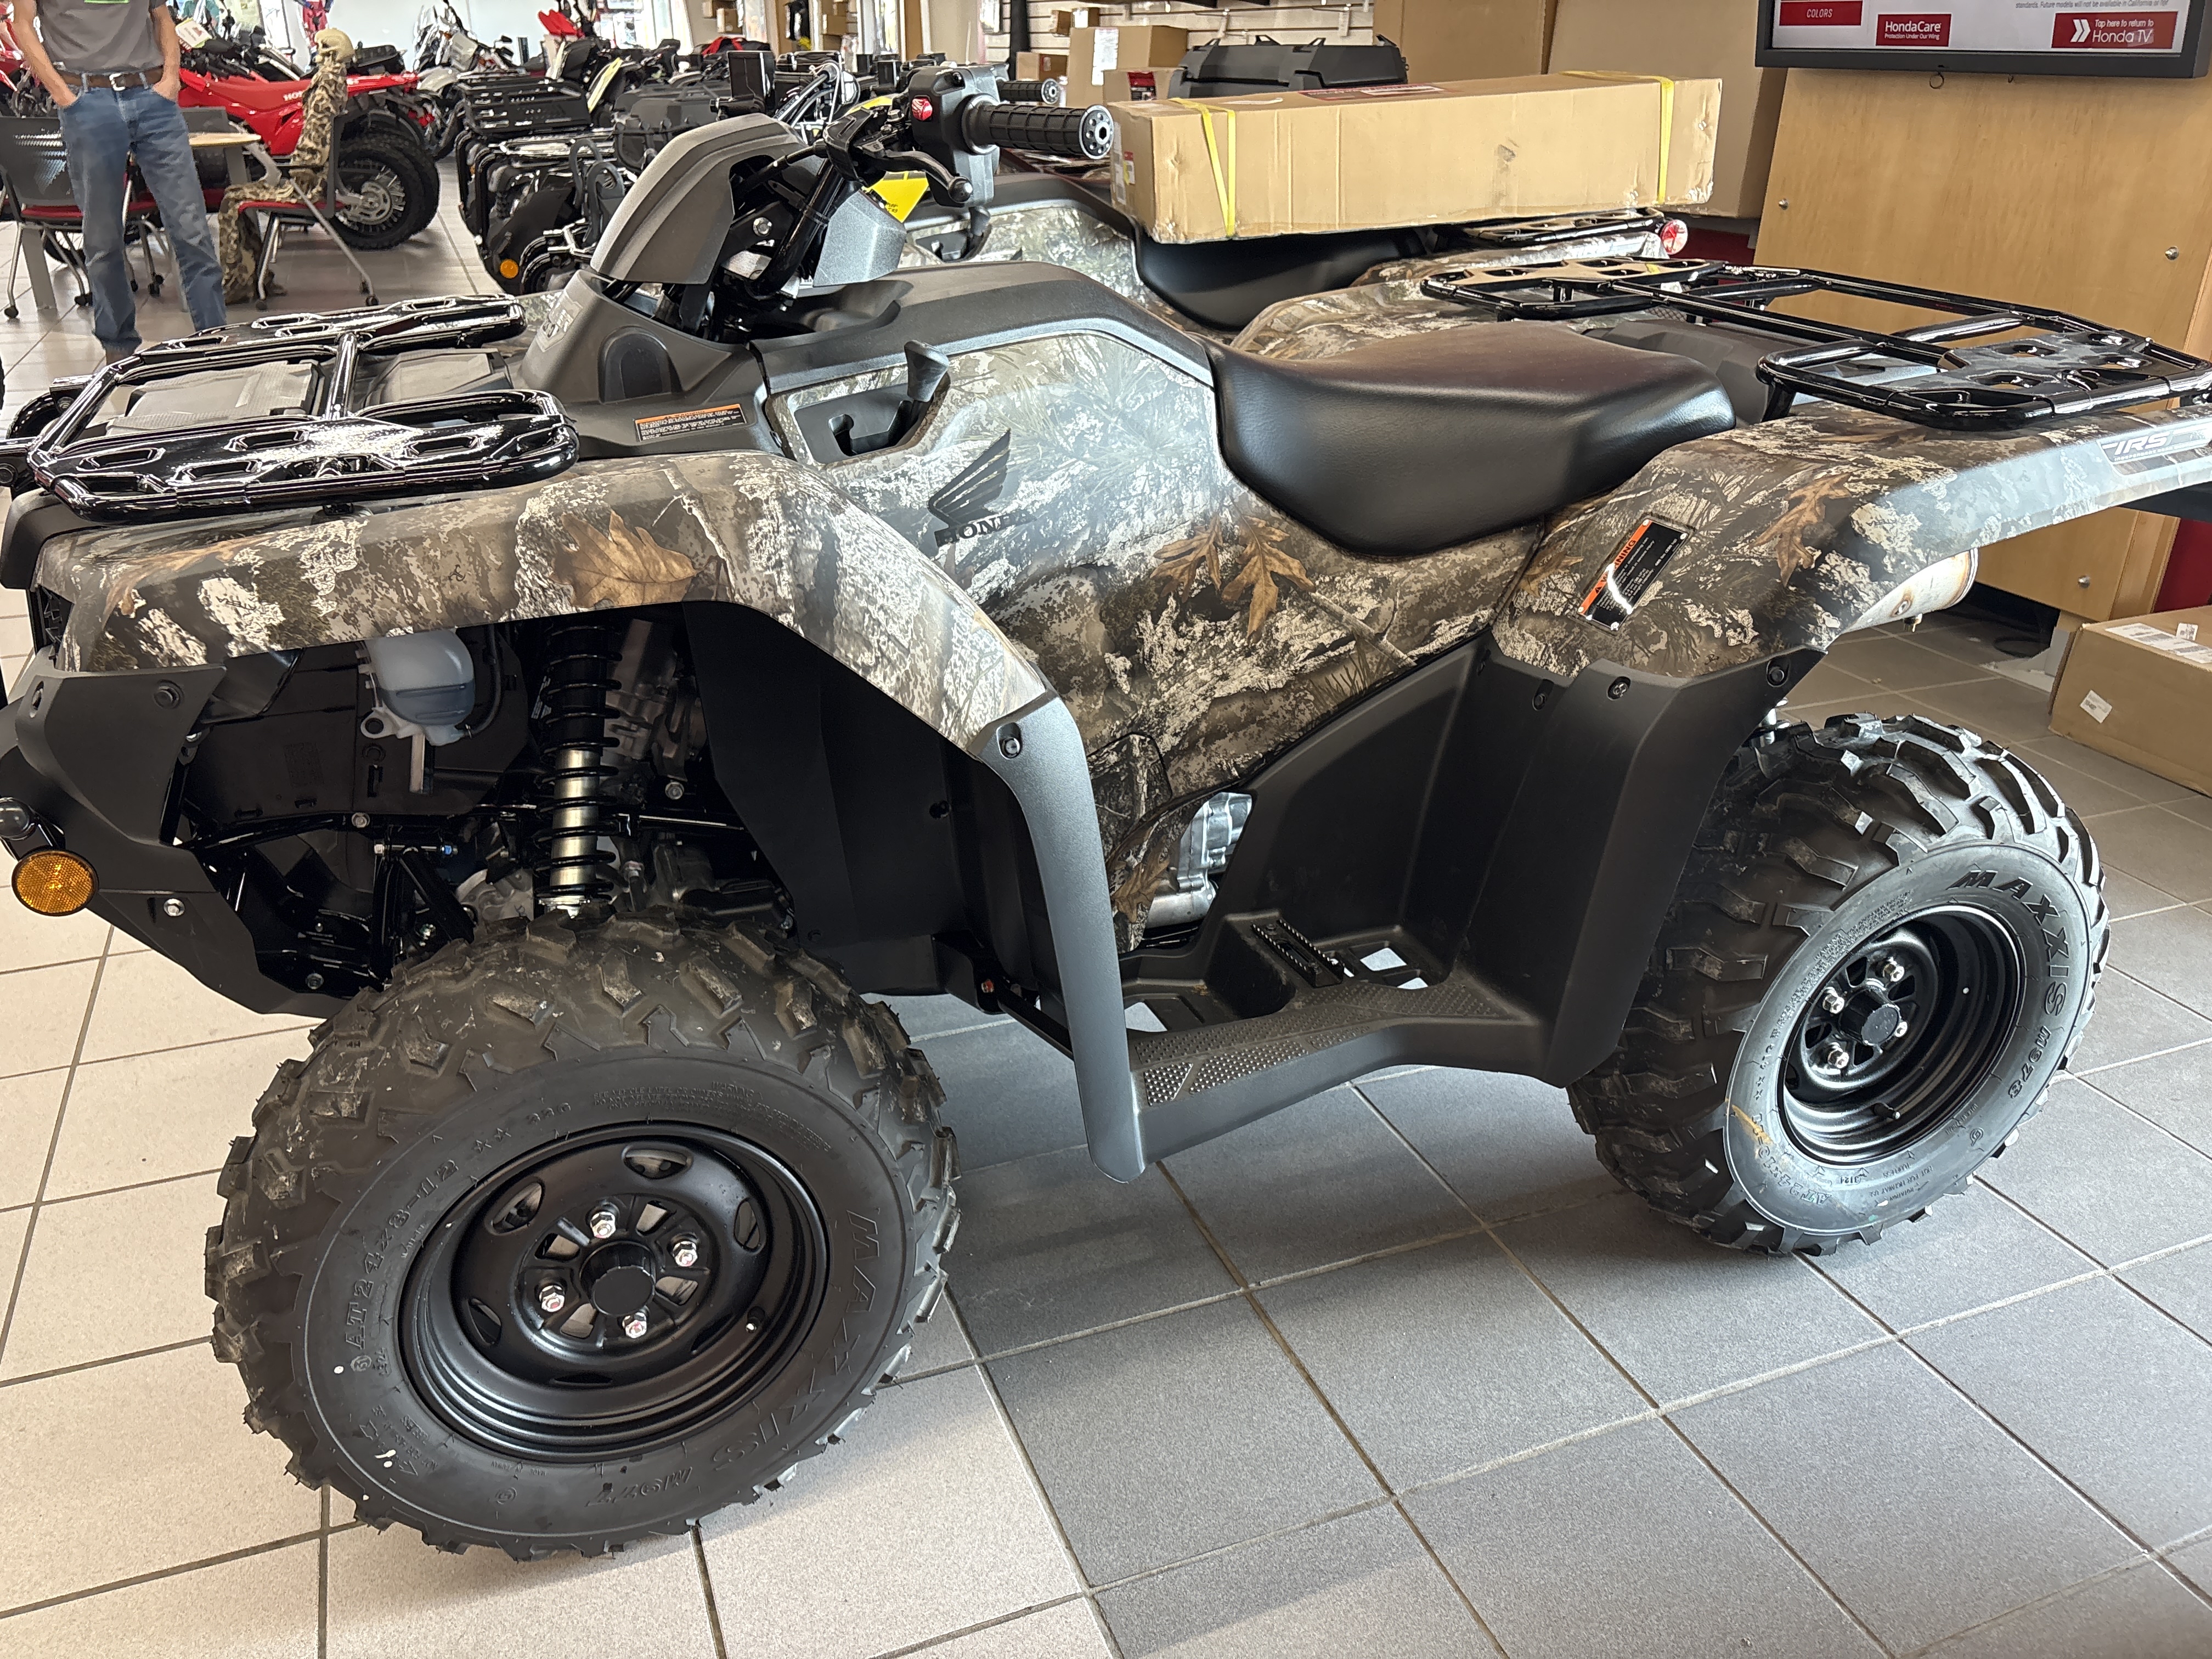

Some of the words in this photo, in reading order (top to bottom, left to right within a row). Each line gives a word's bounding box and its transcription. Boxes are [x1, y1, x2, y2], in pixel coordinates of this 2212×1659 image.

[1807, 9, 1833, 18] COLORS
[1884, 21, 1942, 32] HondaCare
[2095, 19, 2106, 29] Tap
[2092, 30, 2134, 42] Honda
[2137, 29, 2153, 42] TV
[2114, 431, 2170, 455] IRS
[935, 509, 1037, 548] HONDA
[1600, 539, 1636, 583] WRNING
[1946, 869, 2069, 1016] MAXXIS
[2008, 1025, 2052, 1099] M978
[711, 1209, 880, 1471] MAXXIS
